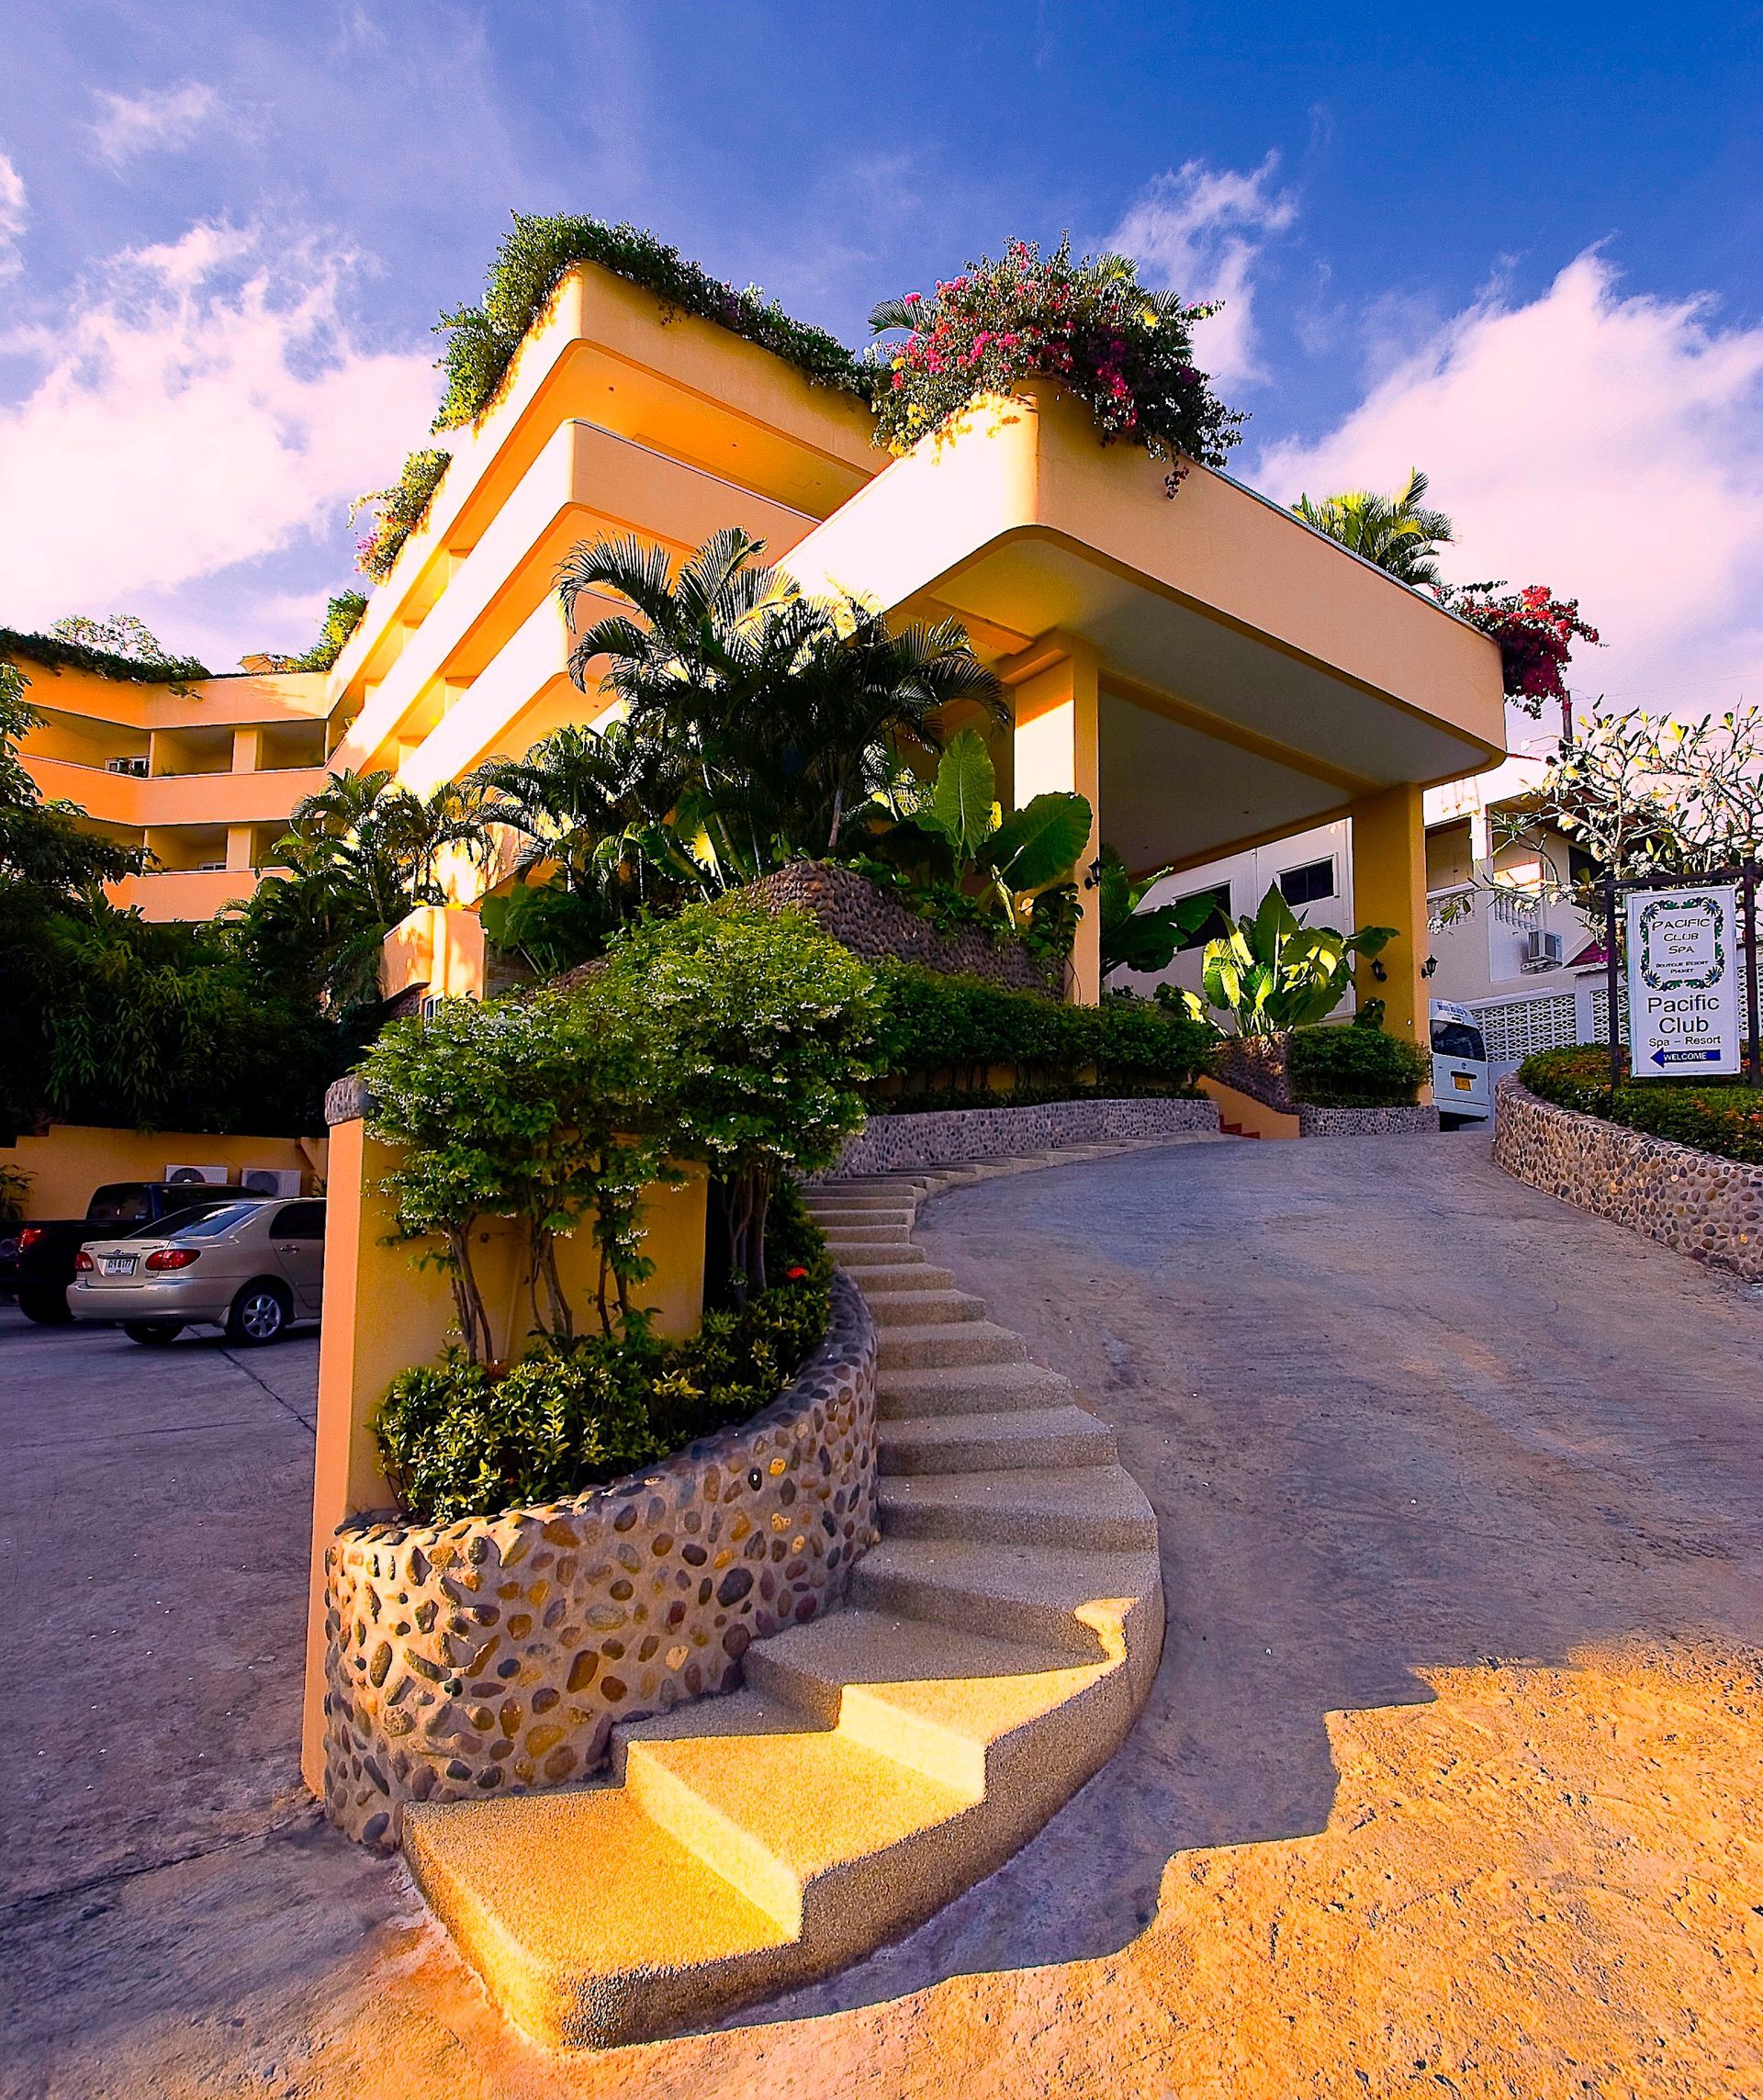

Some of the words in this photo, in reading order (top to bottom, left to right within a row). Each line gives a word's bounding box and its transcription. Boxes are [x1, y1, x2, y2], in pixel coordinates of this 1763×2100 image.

[1652, 918, 1711, 930] PACIFIC
[1663, 933, 1699, 941] CLUB
[1668, 945, 1694, 954] SPA
[1647, 994, 1719, 1013] Pacific
[1658, 1016, 1709, 1034] Club
[1648, 1038, 1669, 1047] Spa
[1685, 1036, 1721, 1045] Resort
[1663, 1051, 1707, 1061] WELCOME
